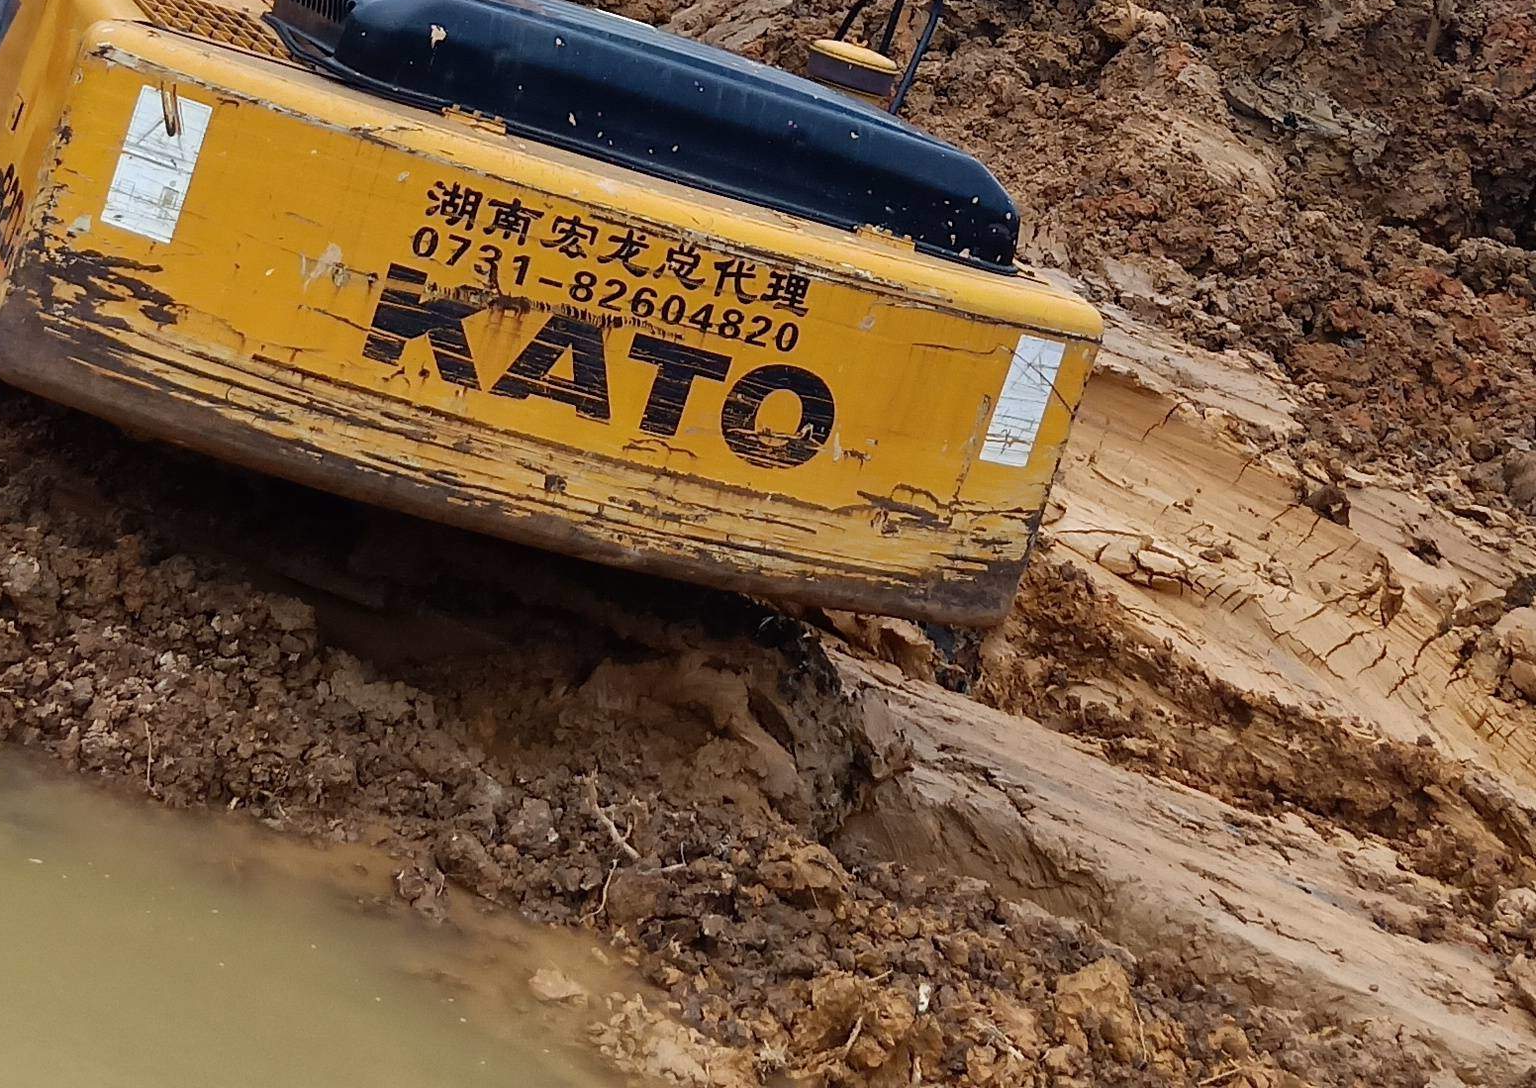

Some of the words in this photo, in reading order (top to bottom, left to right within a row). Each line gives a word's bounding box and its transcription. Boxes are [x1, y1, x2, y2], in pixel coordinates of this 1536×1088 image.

[412, 226, 799, 353] 0731-82604820
[425, 180, 810, 317] 湖南宏龙总代理
[362, 262, 836, 469] KATO
